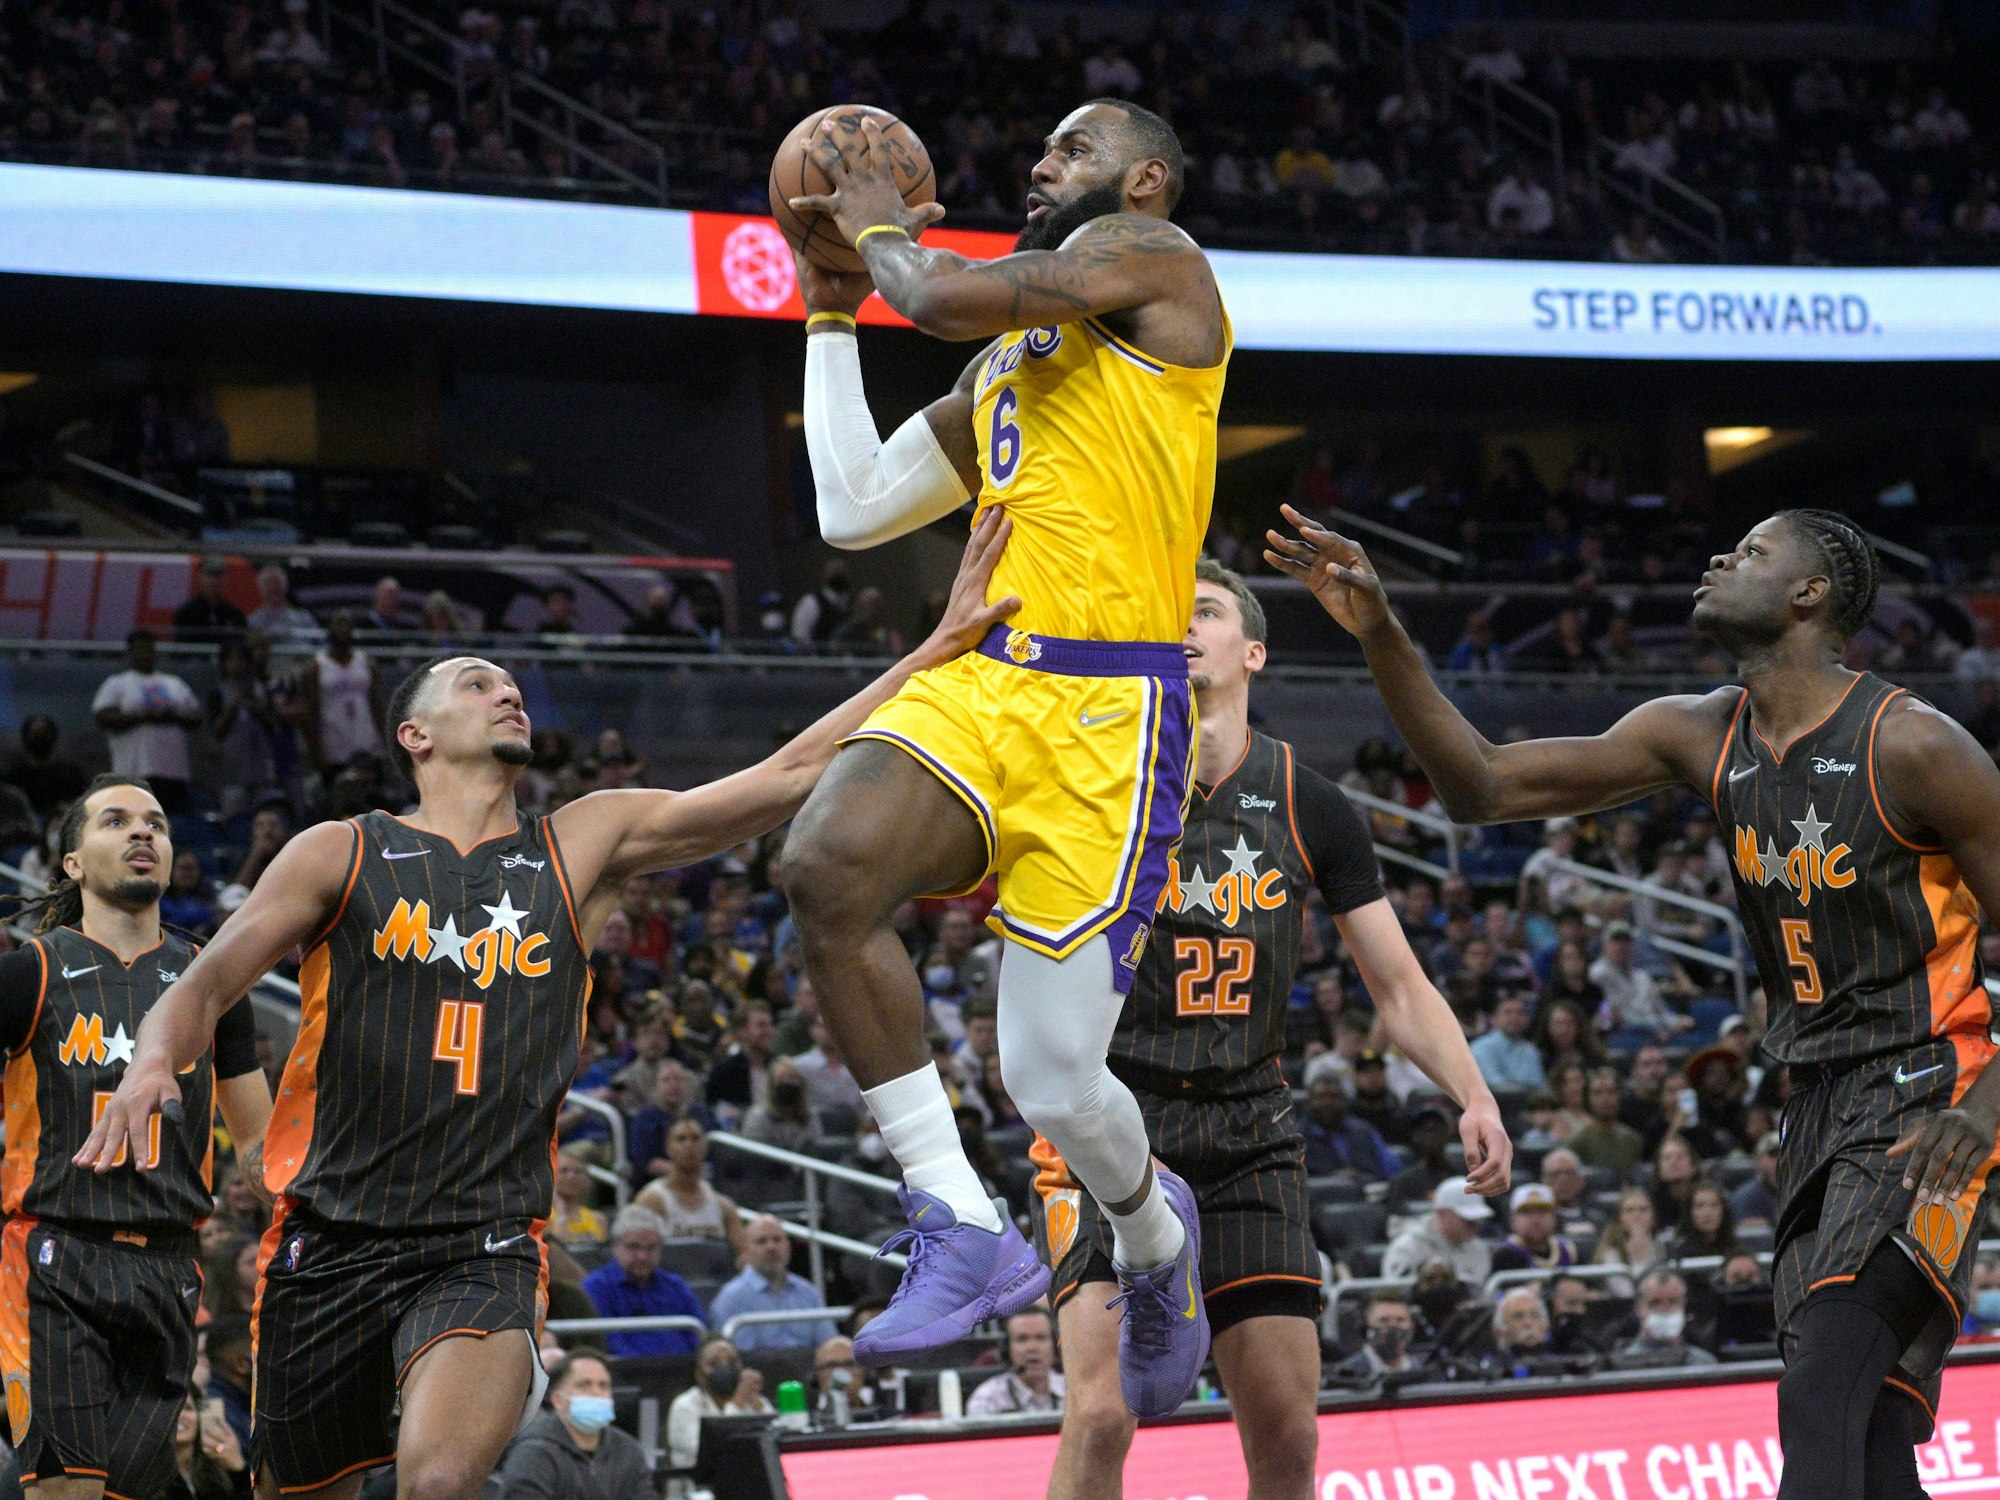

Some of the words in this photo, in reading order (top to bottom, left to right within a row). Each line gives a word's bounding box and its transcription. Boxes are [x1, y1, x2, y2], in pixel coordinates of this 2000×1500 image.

[1532, 287, 1639, 332] STEP
[1650, 291, 1883, 335] FORWARD.
[989, 384, 1022, 490] 6
[1174, 936, 1256, 1017] 22
[1779, 917, 1824, 1005] 5
[432, 999, 484, 1096] 4
[1470, 1449, 1630, 1500] NEXT
